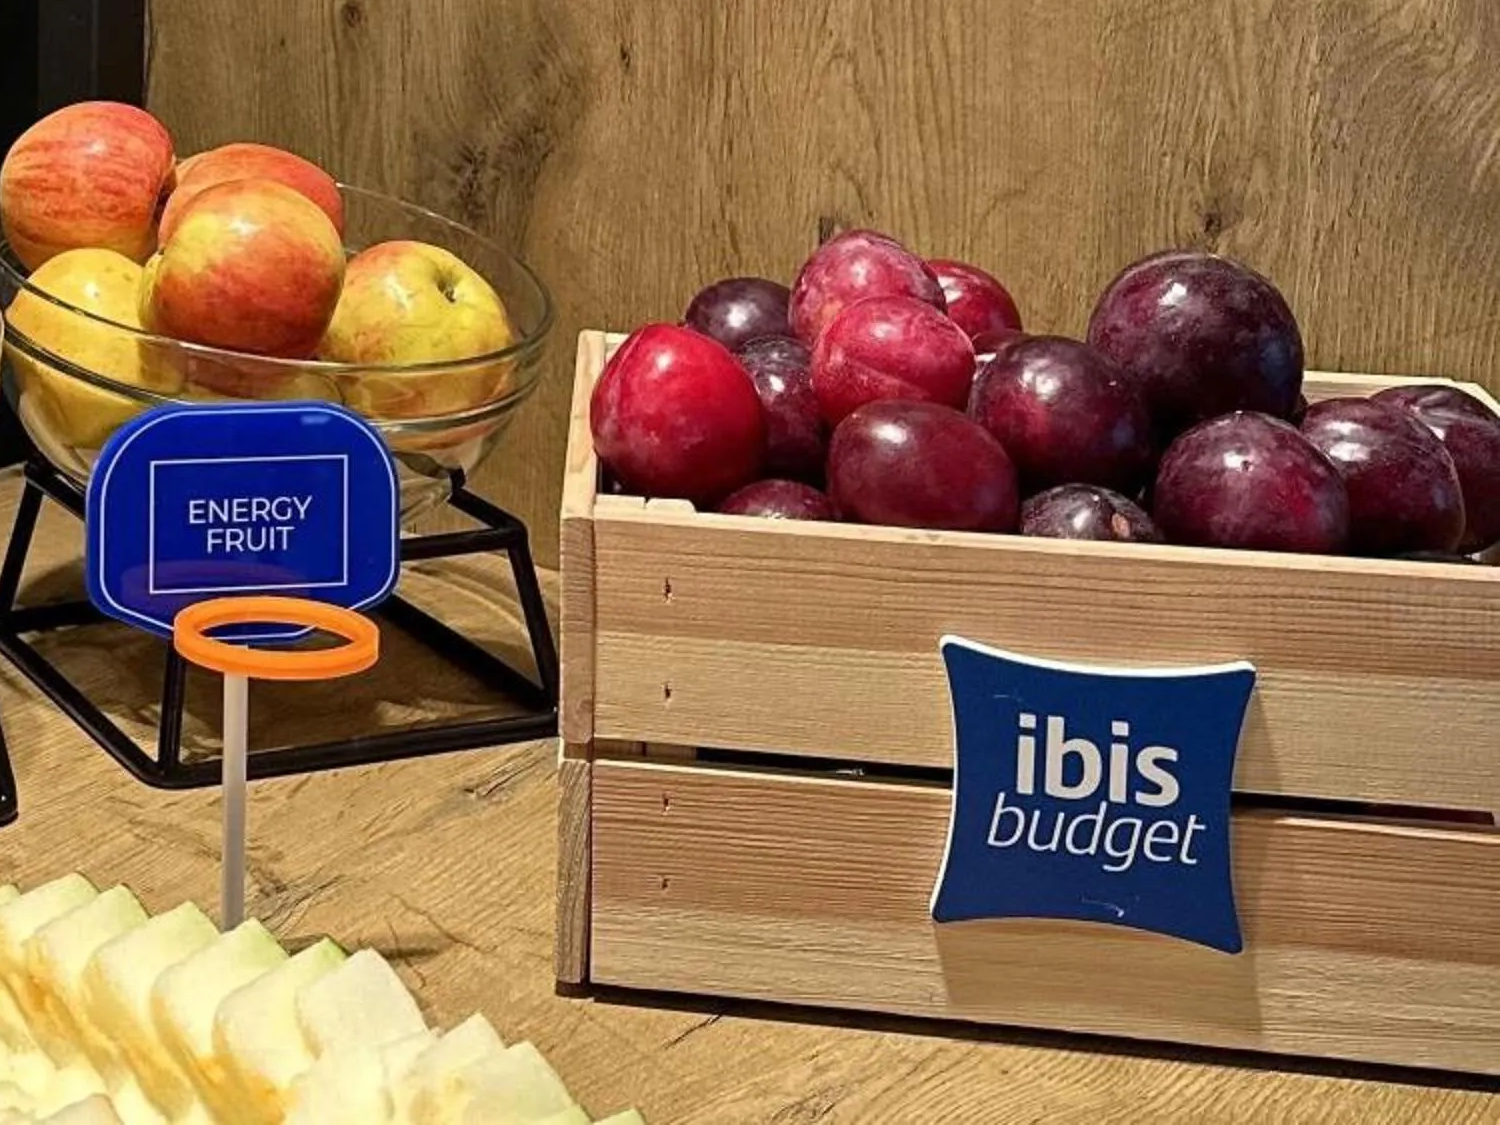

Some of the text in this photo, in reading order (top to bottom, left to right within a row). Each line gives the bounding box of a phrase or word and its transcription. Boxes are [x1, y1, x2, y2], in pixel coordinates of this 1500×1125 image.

[188, 495, 313, 524] ENERGY
[207, 526, 295, 553] FRUIT
[1016, 713, 1180, 807] ibis
[987, 792, 1206, 872] budget
